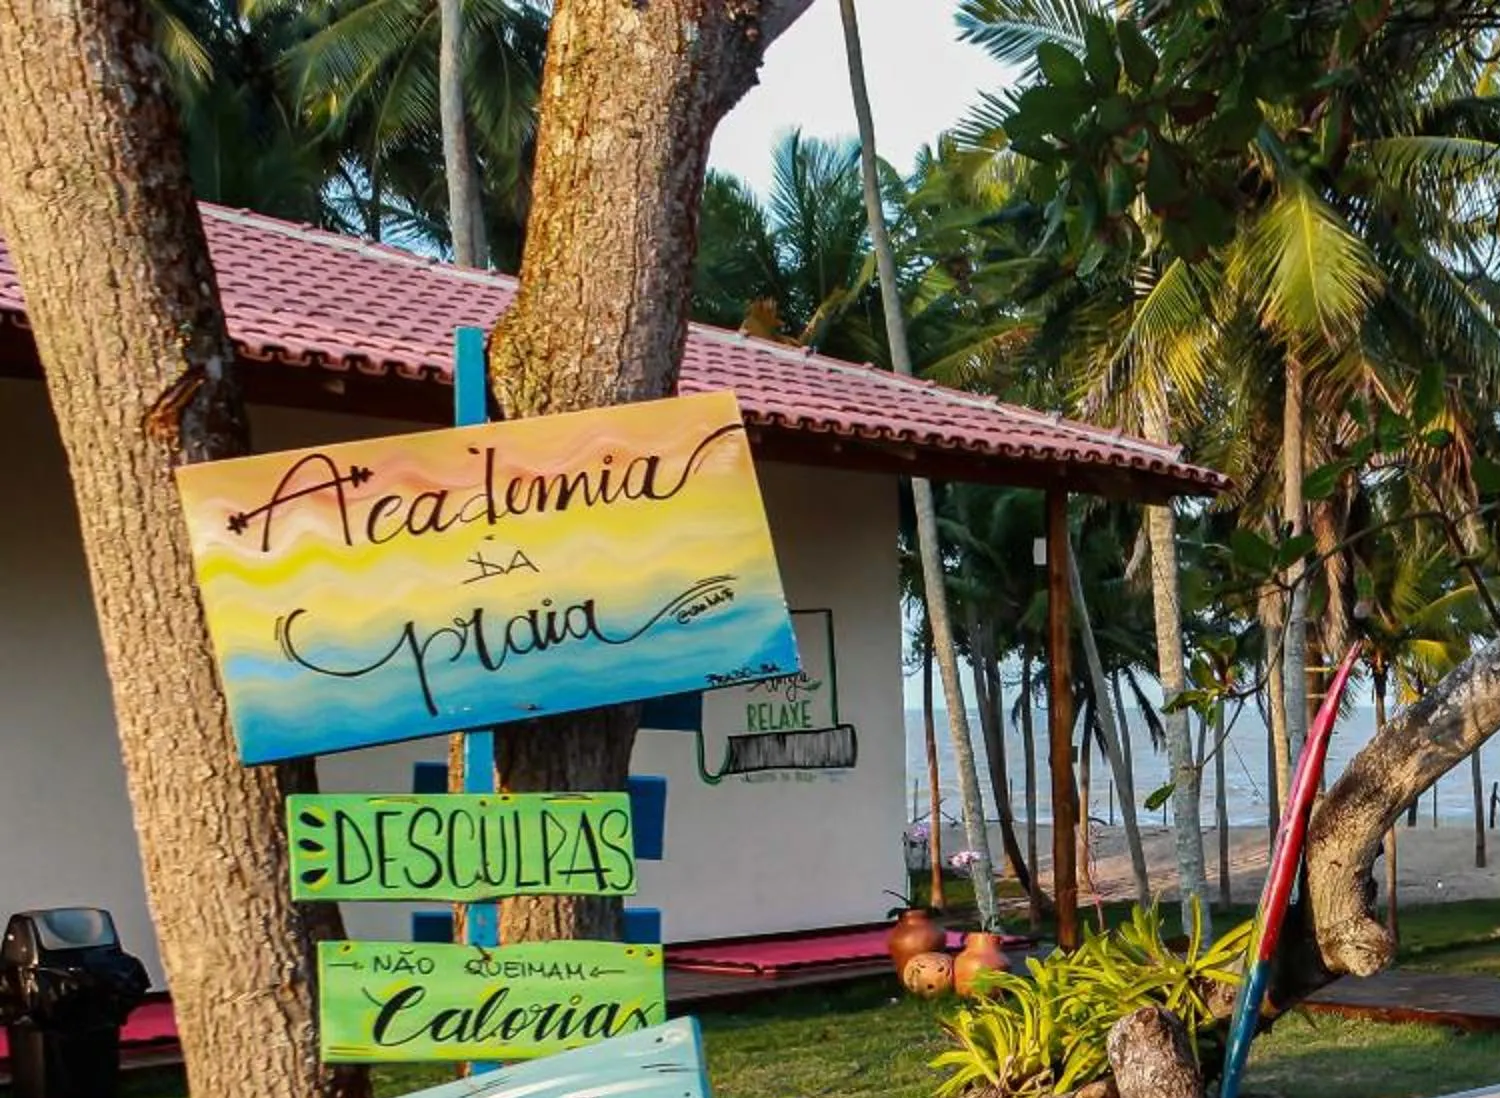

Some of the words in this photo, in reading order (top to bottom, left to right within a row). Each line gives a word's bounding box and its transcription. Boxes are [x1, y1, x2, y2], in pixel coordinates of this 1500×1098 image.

[226, 422, 745, 552] Academia
[461, 550, 541, 584] DA
[746, 701, 813, 730] RELAXE
[334, 805, 634, 891] DESCULPAS
[372, 949, 436, 975] NÃO
[464, 950, 584, 980] QUEIMAM
[362, 984, 660, 1047] Calorias
